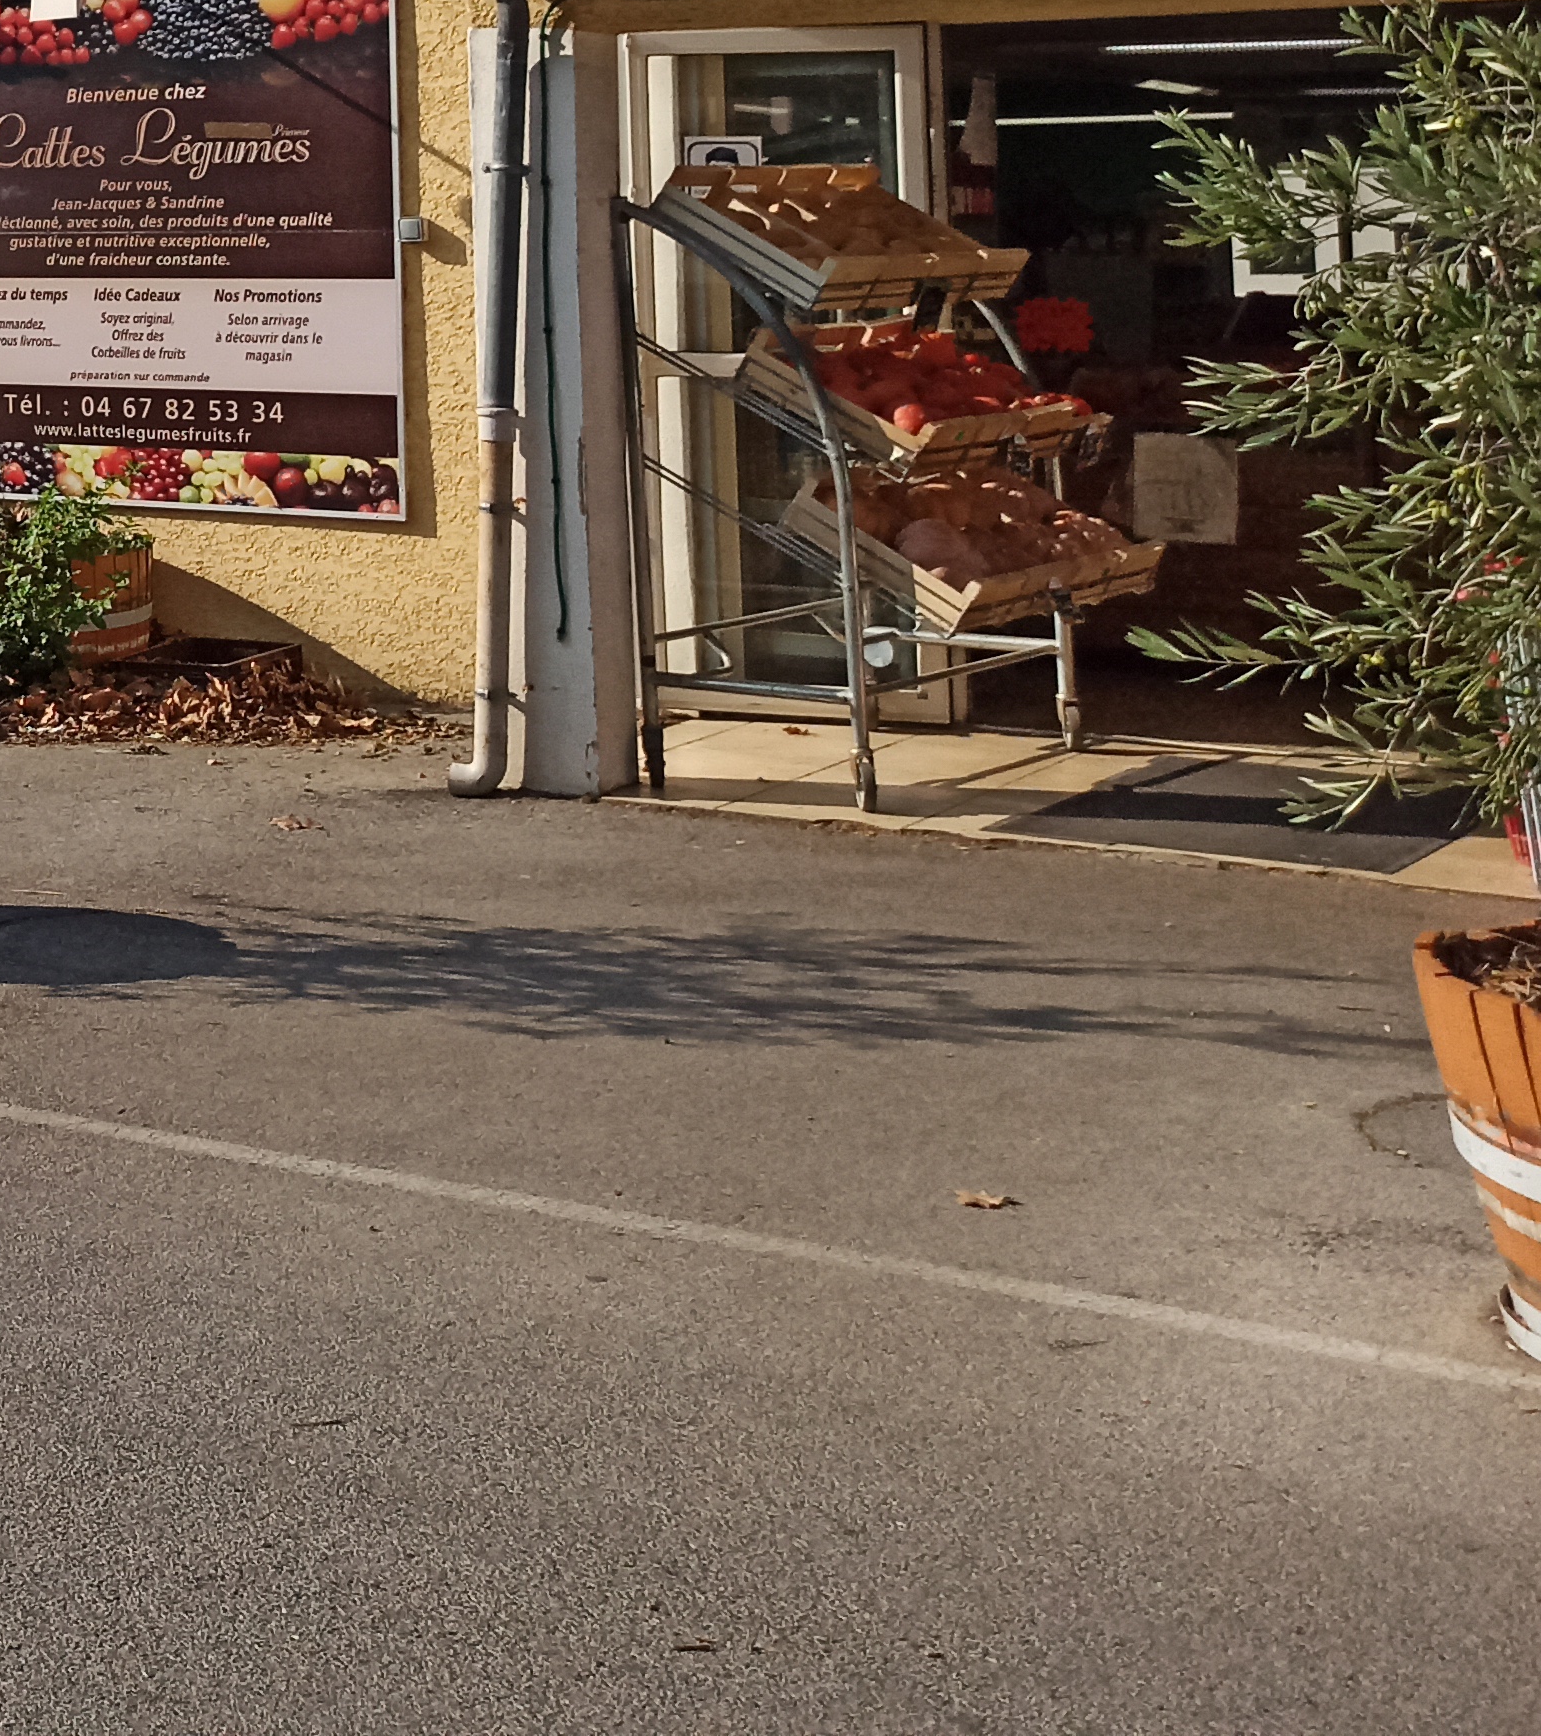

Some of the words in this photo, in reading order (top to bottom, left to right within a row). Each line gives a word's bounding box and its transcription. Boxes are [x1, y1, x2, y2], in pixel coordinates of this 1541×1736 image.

[66, 87, 159, 104] Bienvenue
[165, 83, 206, 101] chez
[120, 107, 312, 180] Légumes
[99, 179, 132, 192] Pour
[136, 180, 172, 193] vous,
[52, 197, 142, 212] Jean-Jacques
[146, 196, 157, 209] &
[160, 195, 225, 209] Sandrine
[67, 217, 98, 229] avec
[101, 215, 135, 230] soin,
[139, 214, 164, 228] des
[167, 214, 228, 230] produits
[232, 213, 275, 227] d'une
[279, 211, 333, 230] qualité
[9, 234, 73, 251] gustative
[76, 235, 91, 248] et
[95, 234, 156, 248] nutritive
[159, 233, 270, 250] exceptionnelle,
[46, 252, 85, 266] d'une
[156, 253, 231, 266] constante.
[11, 287, 26, 301] du
[30, 288, 68, 304] temps
[94, 287, 122, 302] Idée
[125, 287, 181, 302] Cadeaux
[214, 288, 240, 303] Nos
[243, 288, 323, 303] Promotions
[100, 311, 130, 327] Soyez
[227, 313, 258, 326] Selon
[261, 313, 310, 330] arrivage
[112, 329, 144, 342] Offrez
[146, 329, 165, 342] des
[215, 330, 222, 343] à
[225, 331, 279, 344] découvrir
[281, 331, 309, 344] dans
[312, 332, 323, 345] le
[91, 345, 141, 359] Corbeilles
[143, 346, 156, 359] de
[158, 347, 187, 360] fruits
[245, 348, 293, 364] magasin
[69, 370, 131, 382] préparation
[133, 373, 150, 381] sur
[152, 372, 211, 383] commande
[3, 393, 51, 416] Tél.
[80, 396, 112, 418] 04
[122, 398, 152, 419] 67
[165, 399, 196, 421] 82
[208, 400, 239, 422] 53
[251, 401, 284, 424] 34
[34, 423, 252, 444] www.latteslegumesfruits.fr
